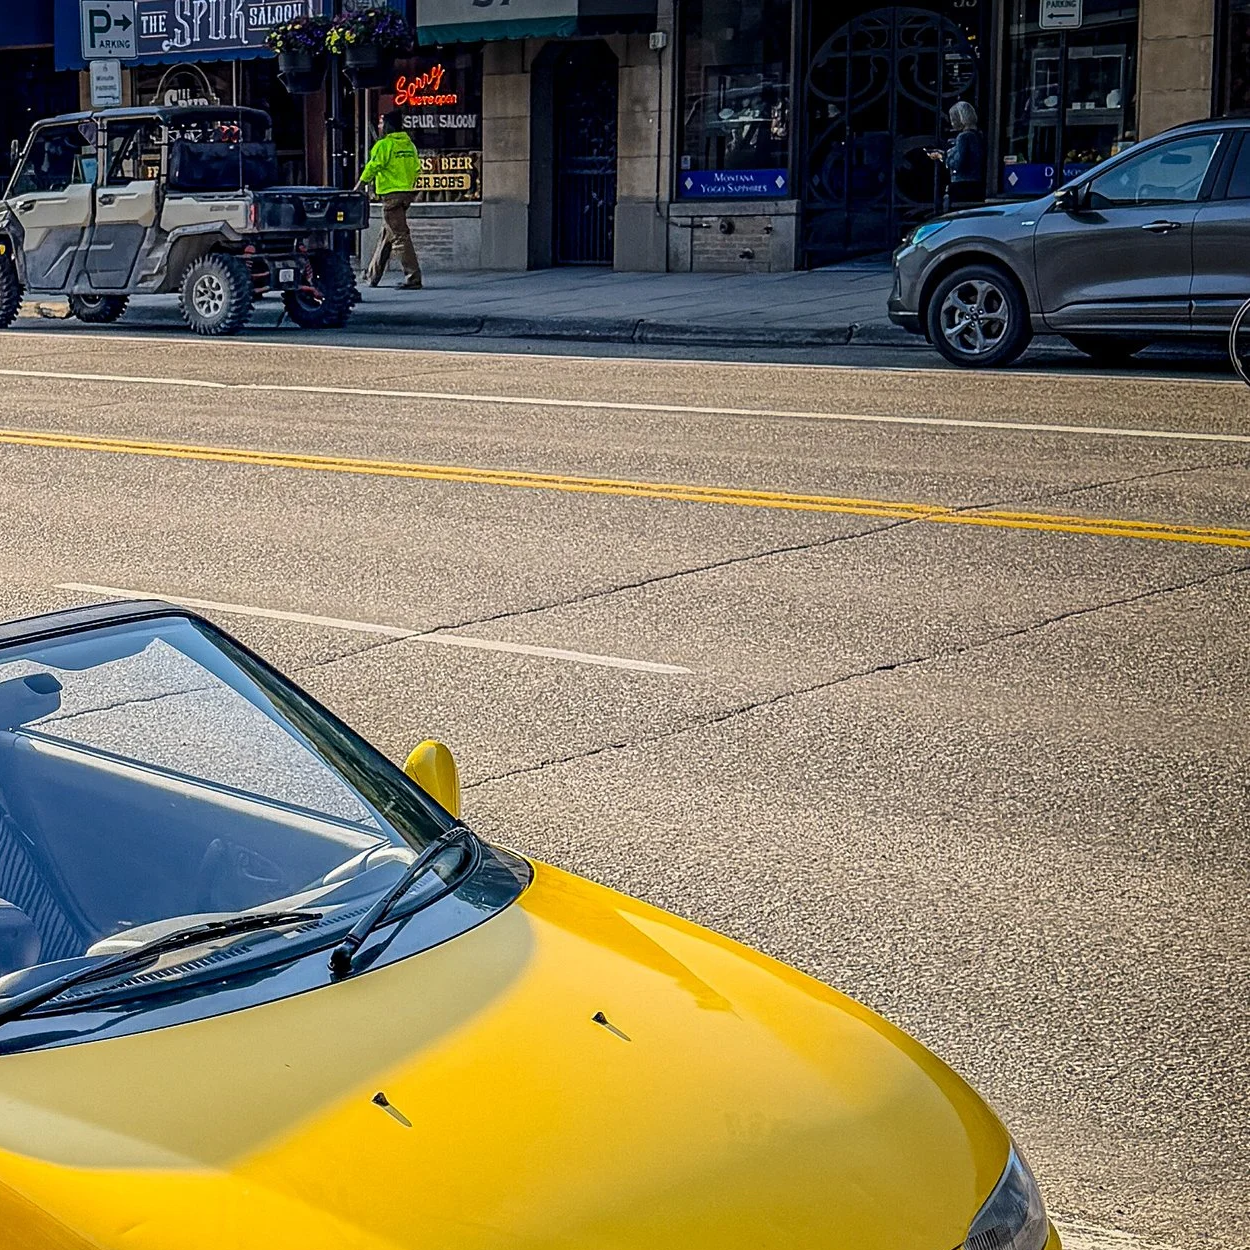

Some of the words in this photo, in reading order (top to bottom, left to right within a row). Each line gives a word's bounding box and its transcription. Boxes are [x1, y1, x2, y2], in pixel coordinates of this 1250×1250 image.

[141, 15, 167, 34] THE
[162, 0, 248, 51] SPUR
[250, 3, 302, 26] SALOON
[395, 64, 445, 106] Sorry
[403, 115, 435, 128] SPUR
[439, 114, 476, 128] SALOON
[441, 157, 474, 170] BEER
